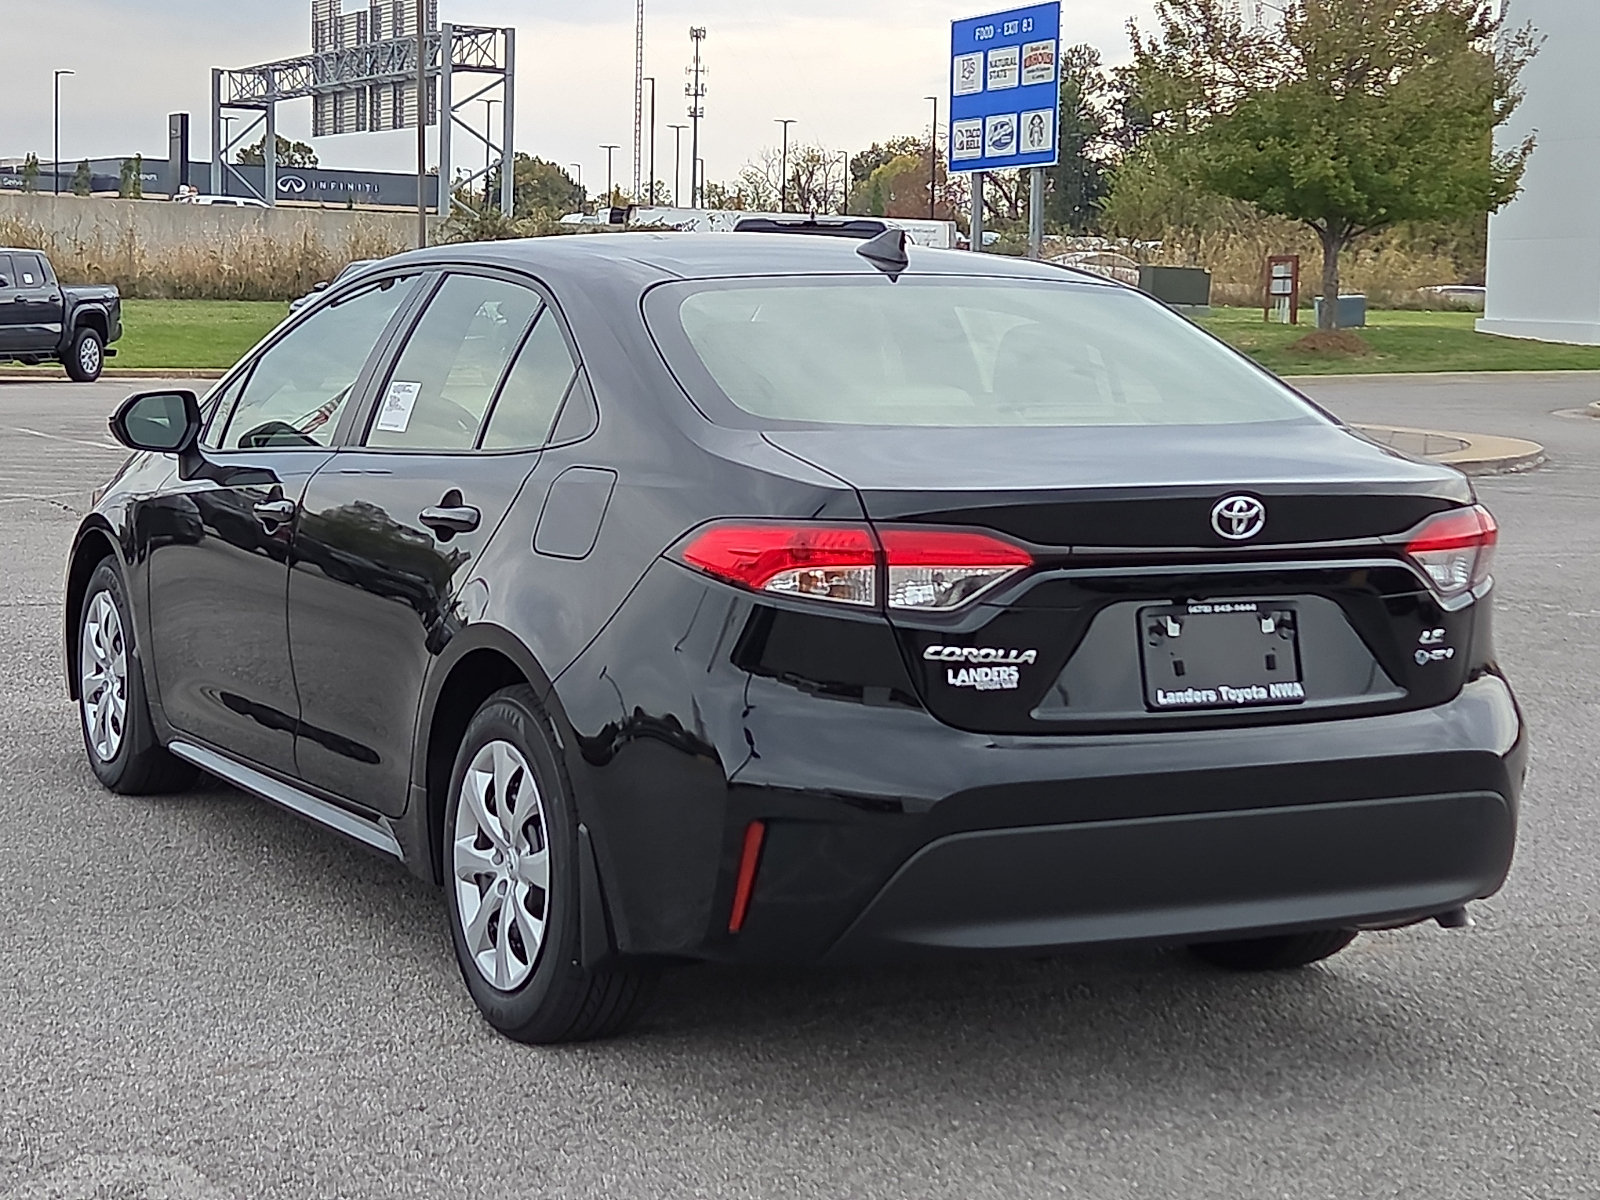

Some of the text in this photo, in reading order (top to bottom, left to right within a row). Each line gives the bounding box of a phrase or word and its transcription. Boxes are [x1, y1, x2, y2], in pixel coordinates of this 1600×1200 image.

[974, 25, 995, 41] FOOD
[1003, 20, 1019, 36] EXIT
[989, 69, 1008, 81] STATE
[964, 127, 981, 139] TACO
[965, 139, 981, 151] BELL
[312, 180, 380, 193] INFINITI
[922, 645, 1037, 664] COROLLA
[947, 666, 1020, 687] LANDERS
[1156, 681, 1304, 705] Landers Toyota NWA
